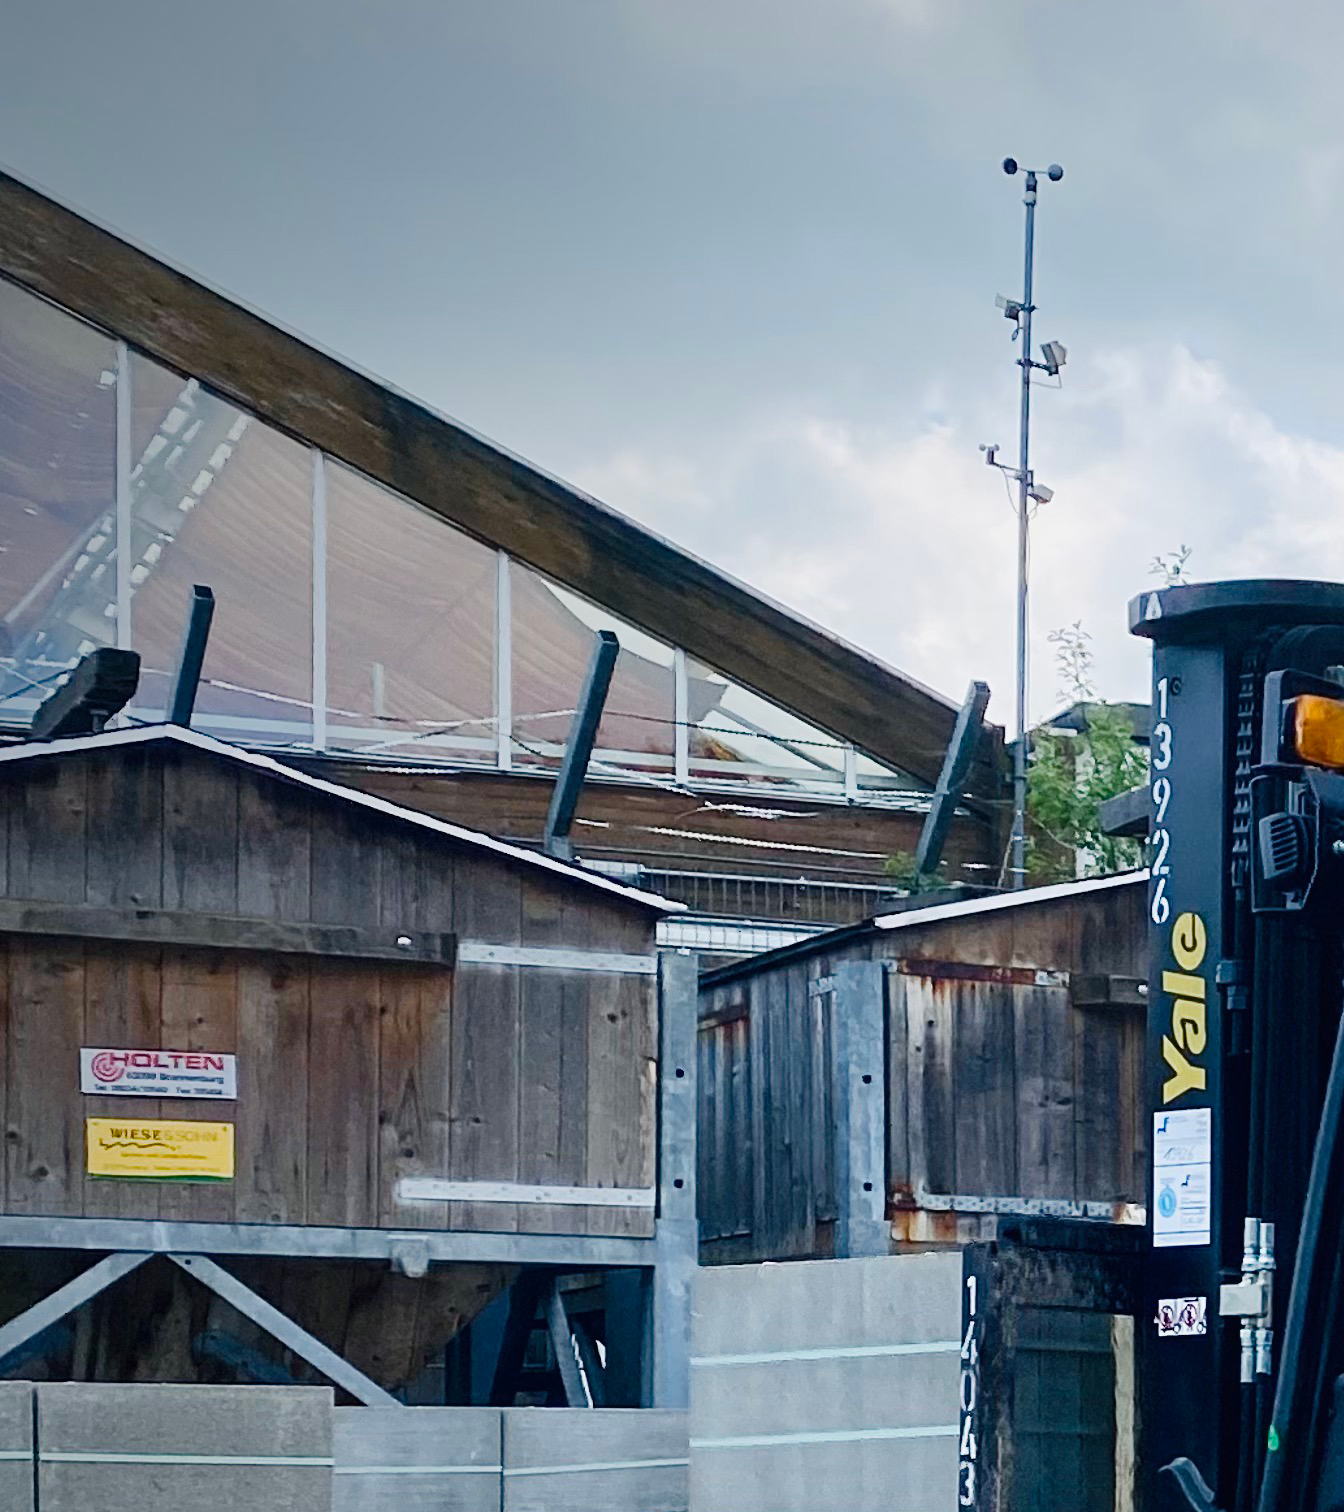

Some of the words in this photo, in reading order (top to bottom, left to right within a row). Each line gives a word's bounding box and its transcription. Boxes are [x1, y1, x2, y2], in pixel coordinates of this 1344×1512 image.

[1151, 677, 1172, 924] 13926
[109, 1052, 224, 1071] HOLTEN
[1162, 911, 1207, 1105] Yale
[959, 1275, 978, 1506] 14043
